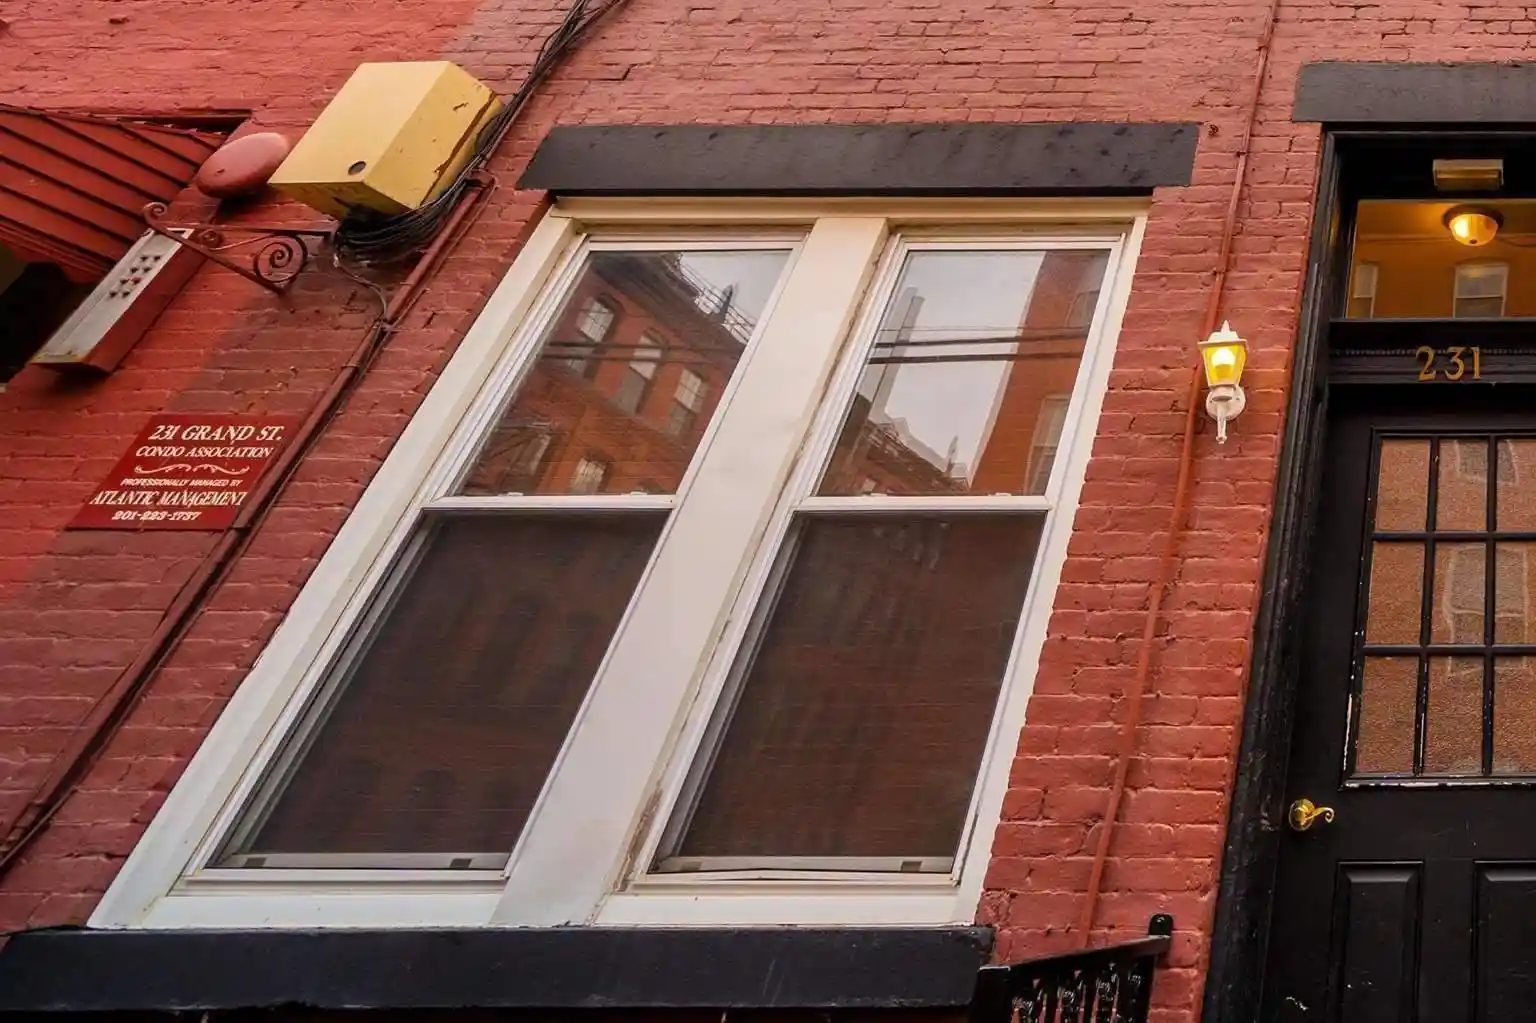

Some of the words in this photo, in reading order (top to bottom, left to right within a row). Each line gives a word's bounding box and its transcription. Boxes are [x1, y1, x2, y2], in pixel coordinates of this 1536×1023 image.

[1416, 346, 1481, 380] 231
[148, 425, 180, 440] 231
[181, 425, 256, 441] GRAND
[256, 426, 285, 441] ST.
[136, 446, 185, 457] CONDO
[185, 447, 274, 458] ASSOCIATION
[120, 478, 190, 487] PROFESSIONALLY
[190, 479, 230, 487] MANAGED
[230, 479, 243, 487] BY
[89, 490, 159, 505] ATLANTIC
[157, 491, 248, 506] MANAGEMENT
